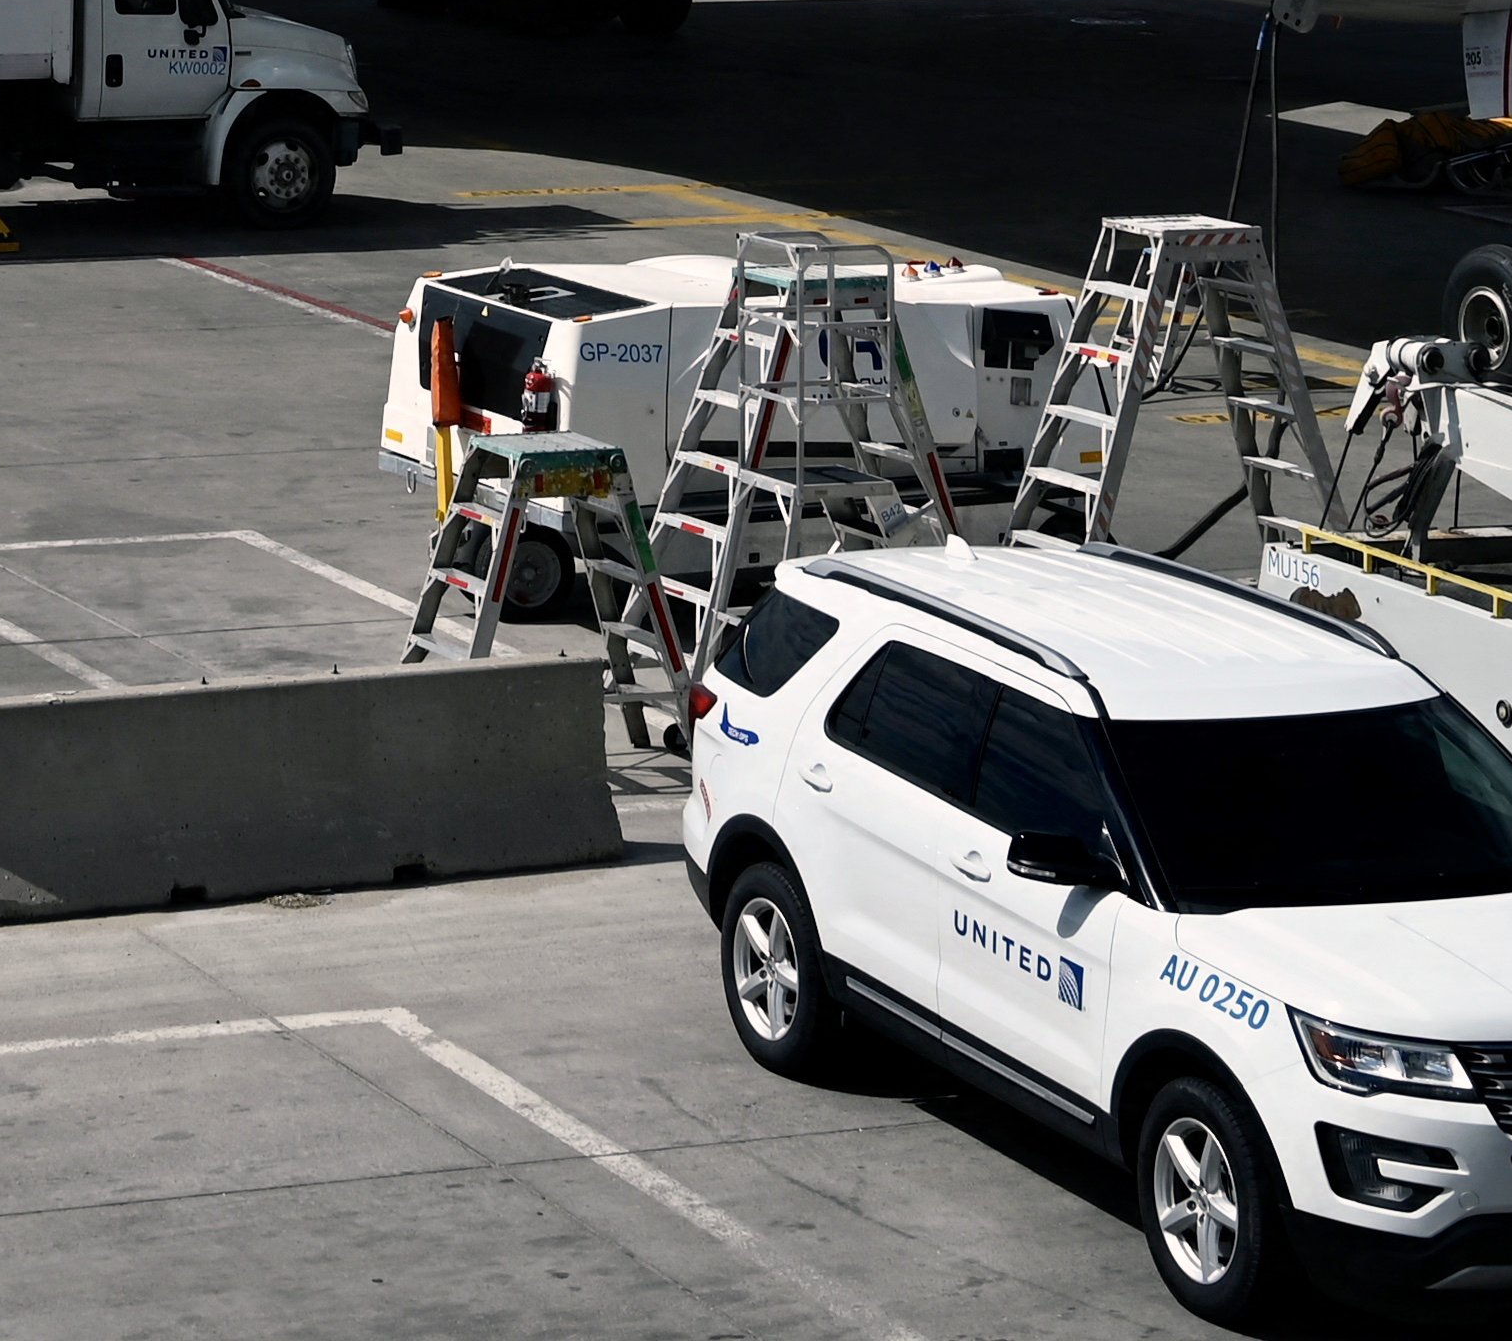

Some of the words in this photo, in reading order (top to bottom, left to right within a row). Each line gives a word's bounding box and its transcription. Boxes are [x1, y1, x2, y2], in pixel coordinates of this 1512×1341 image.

[147, 49, 209, 59] UNITED
[1465, 50, 1482, 66] 205
[168, 61, 226, 76] KW0002
[579, 342, 663, 364] GP-2037
[1268, 550, 1320, 588] MU156
[954, 909, 1052, 982] UNITED
[1159, 954, 1199, 991] AU
[1199, 973, 1270, 1030] 0250
